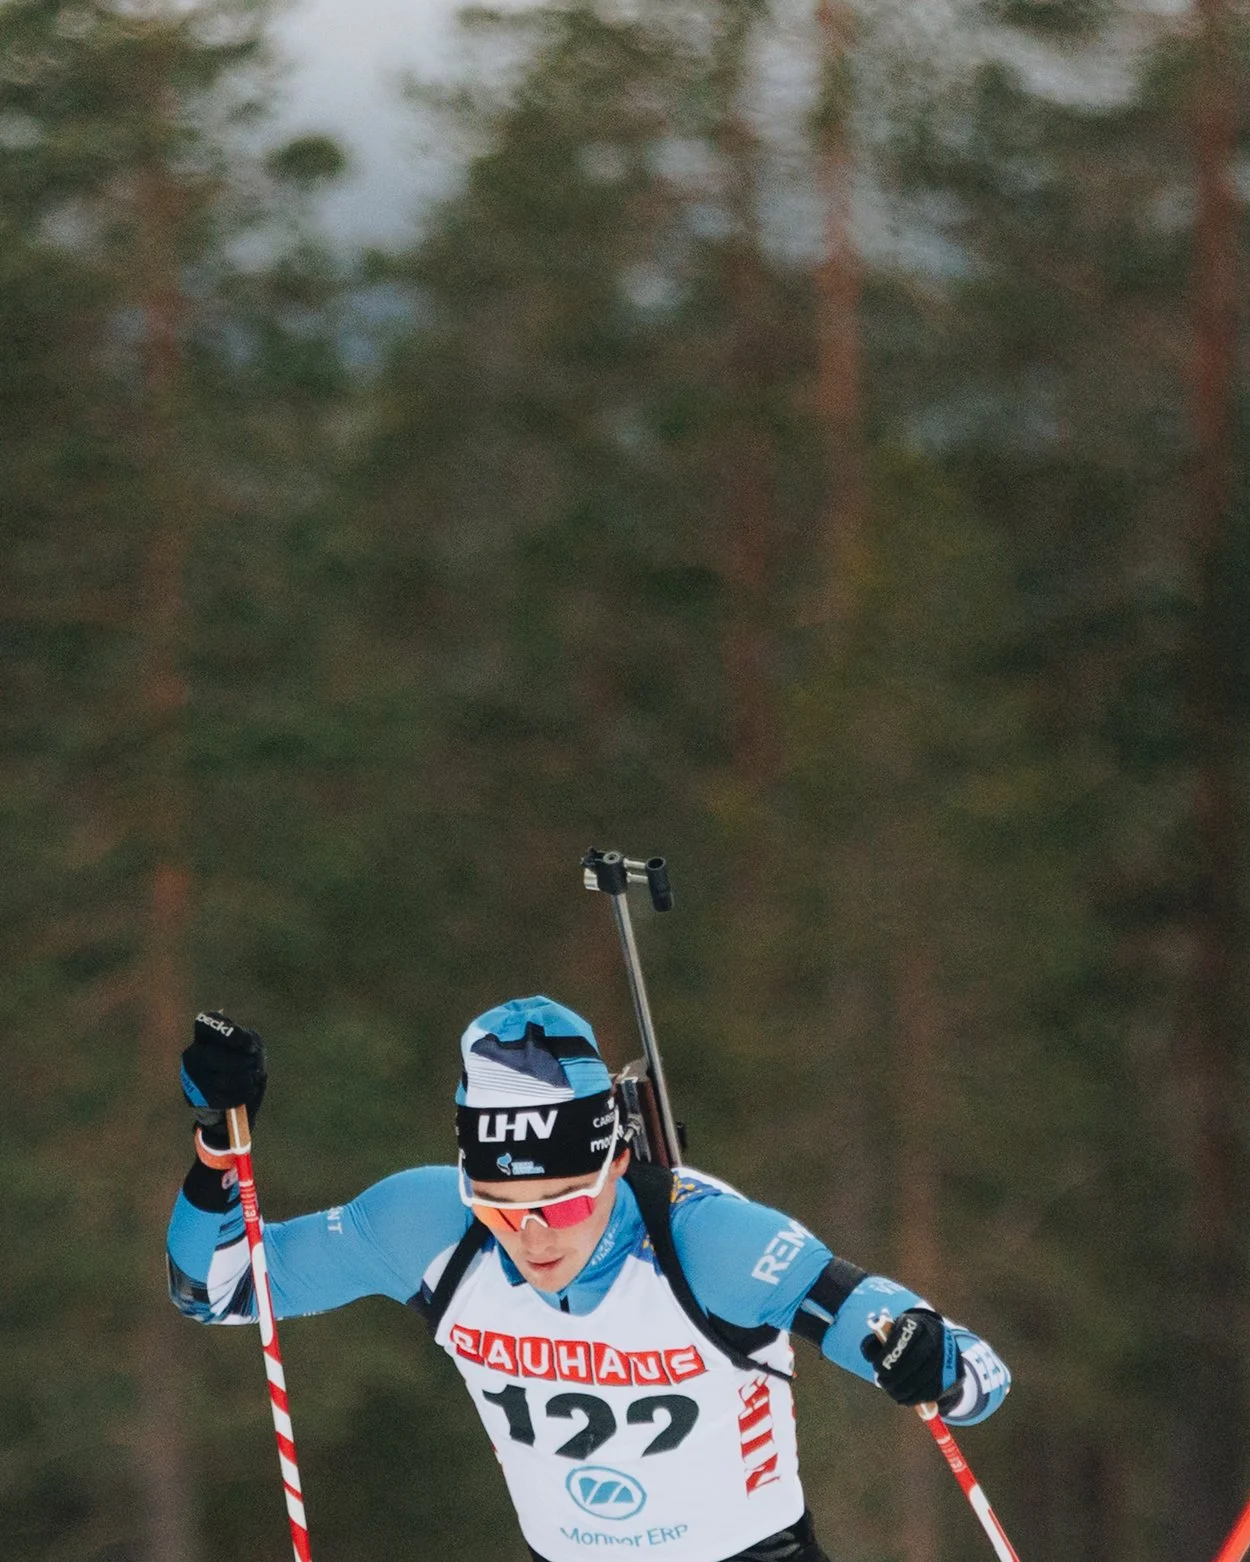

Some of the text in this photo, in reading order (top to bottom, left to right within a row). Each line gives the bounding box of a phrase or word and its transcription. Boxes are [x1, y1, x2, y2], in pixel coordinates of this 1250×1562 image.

[478, 1110, 558, 1143] LHV
[451, 1325, 704, 1385] BAUHAUS
[482, 1383, 700, 1460] 122
[646, 1523, 688, 1546] ERP
